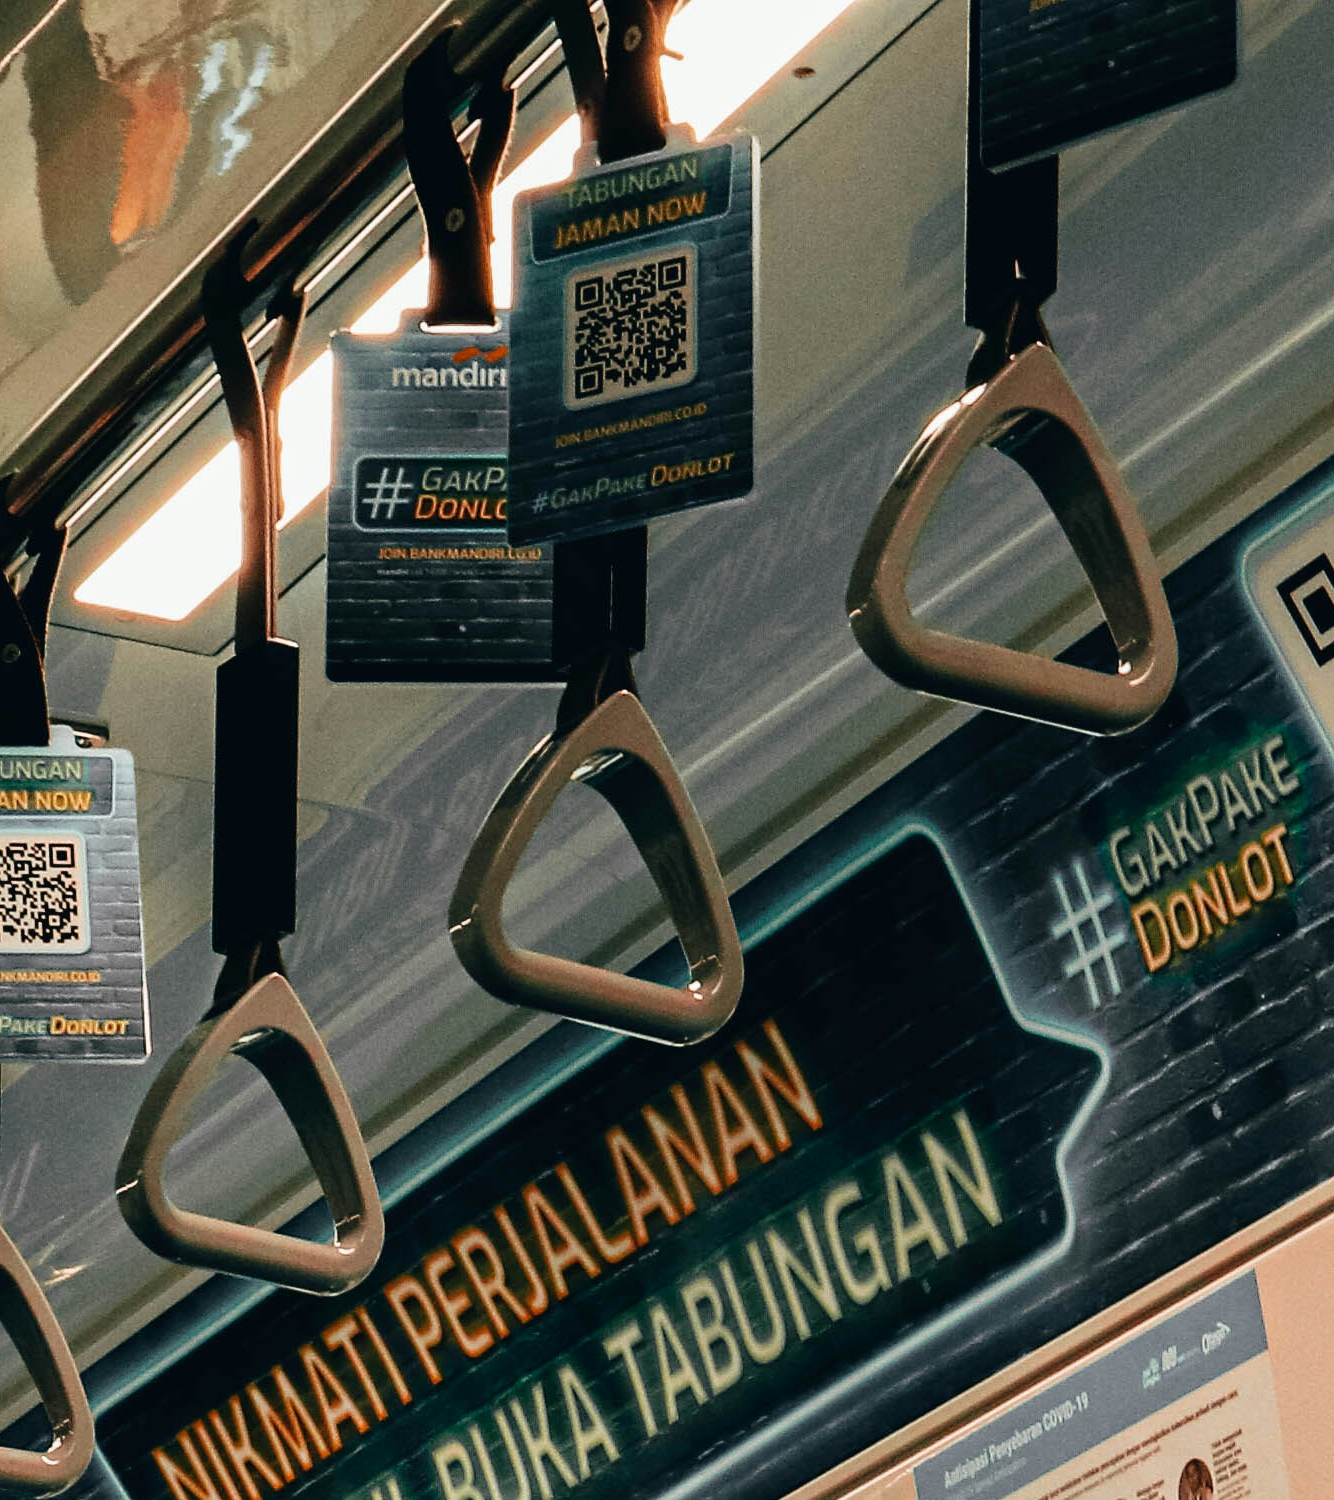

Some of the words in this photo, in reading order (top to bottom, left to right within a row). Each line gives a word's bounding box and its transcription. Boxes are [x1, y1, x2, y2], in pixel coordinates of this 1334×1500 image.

[566, 158, 697, 209] TABUNGAN
[554, 204, 639, 250] JAMAN
[646, 192, 707, 229] NOW
[422, 466, 507, 492] GAKP
[651, 452, 735, 488] DONLOT
[34, 791, 92, 811] NOW
[1128, 825, 1296, 974] DONLOT
[50, 1016, 129, 1035] DONLOT
[390, 1019, 824, 1386] PERJALANAN
[603, 1109, 1003, 1435] TABUNGAN
[1042, 1391, 1091, 1433] COVID-19
